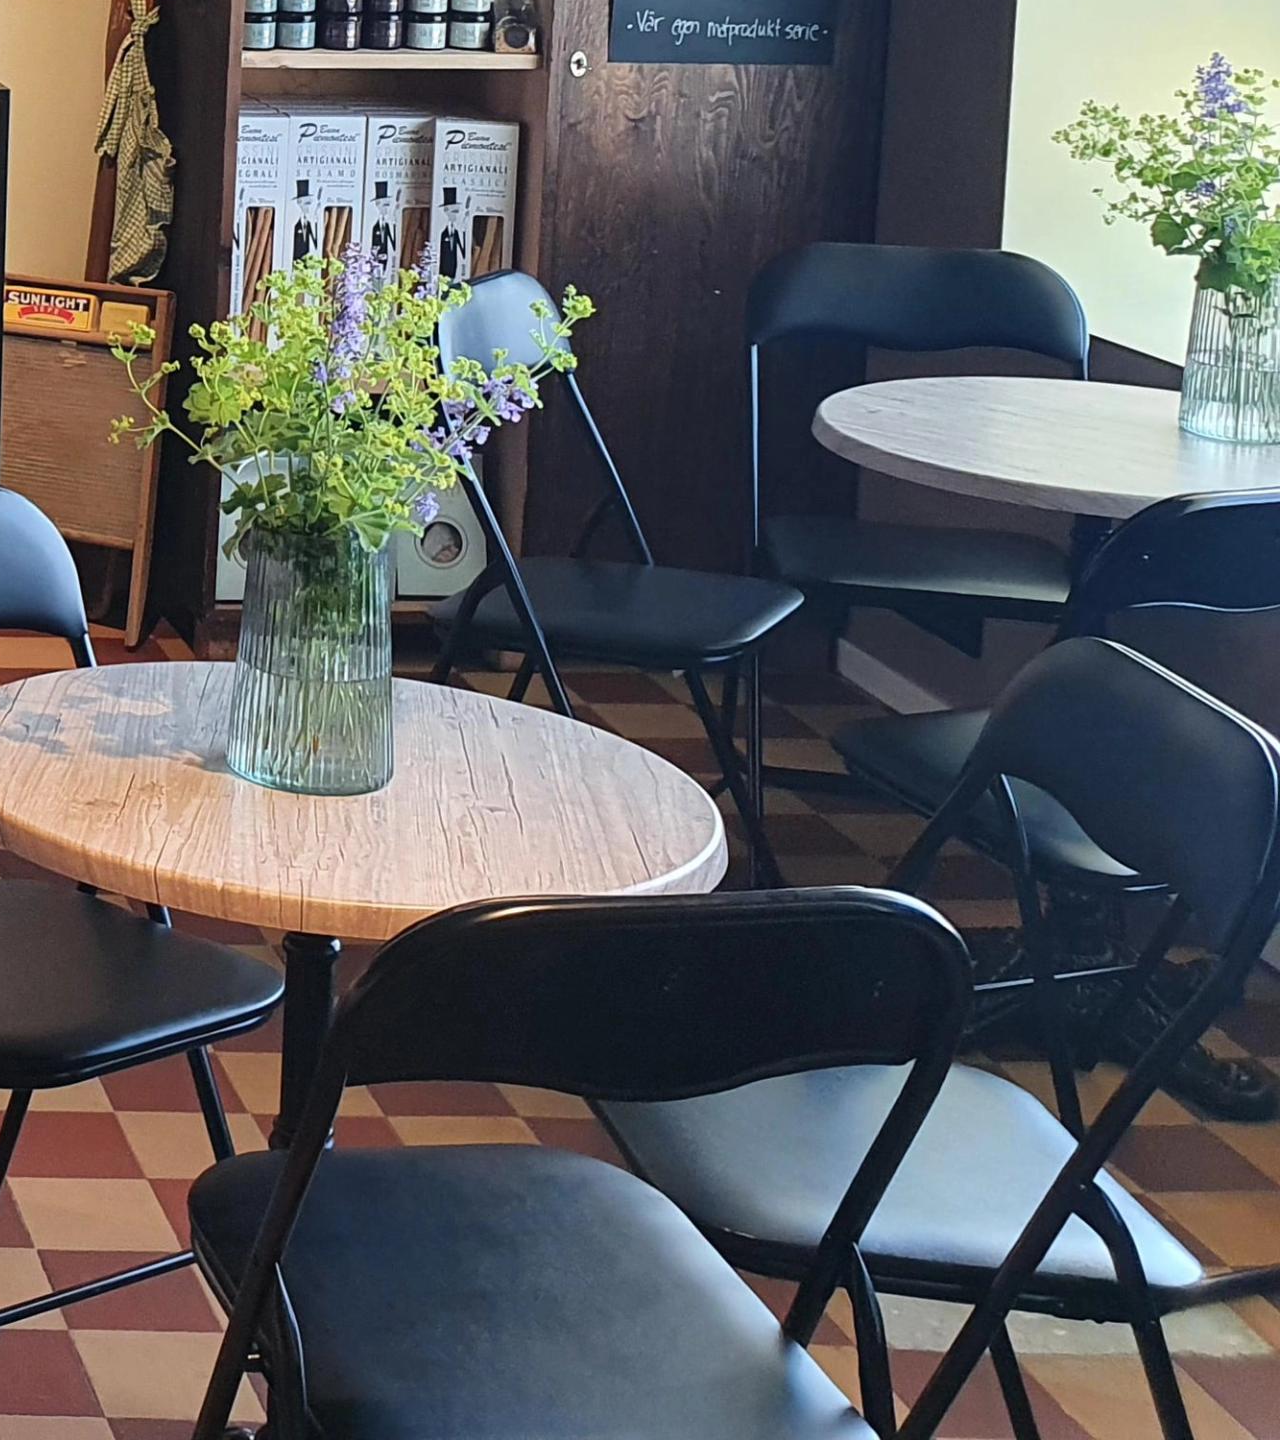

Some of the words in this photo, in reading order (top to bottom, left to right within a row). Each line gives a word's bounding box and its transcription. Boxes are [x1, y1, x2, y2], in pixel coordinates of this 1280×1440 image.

[297, 155, 357, 165] ARTIGIANALI
[376, 158, 431, 166] ARTIGIANAL
[239, 169, 278, 178] EGRALI
[443, 163, 508, 175] ARTIGIANALI
[7, 291, 89, 312] SUNLIGHT
